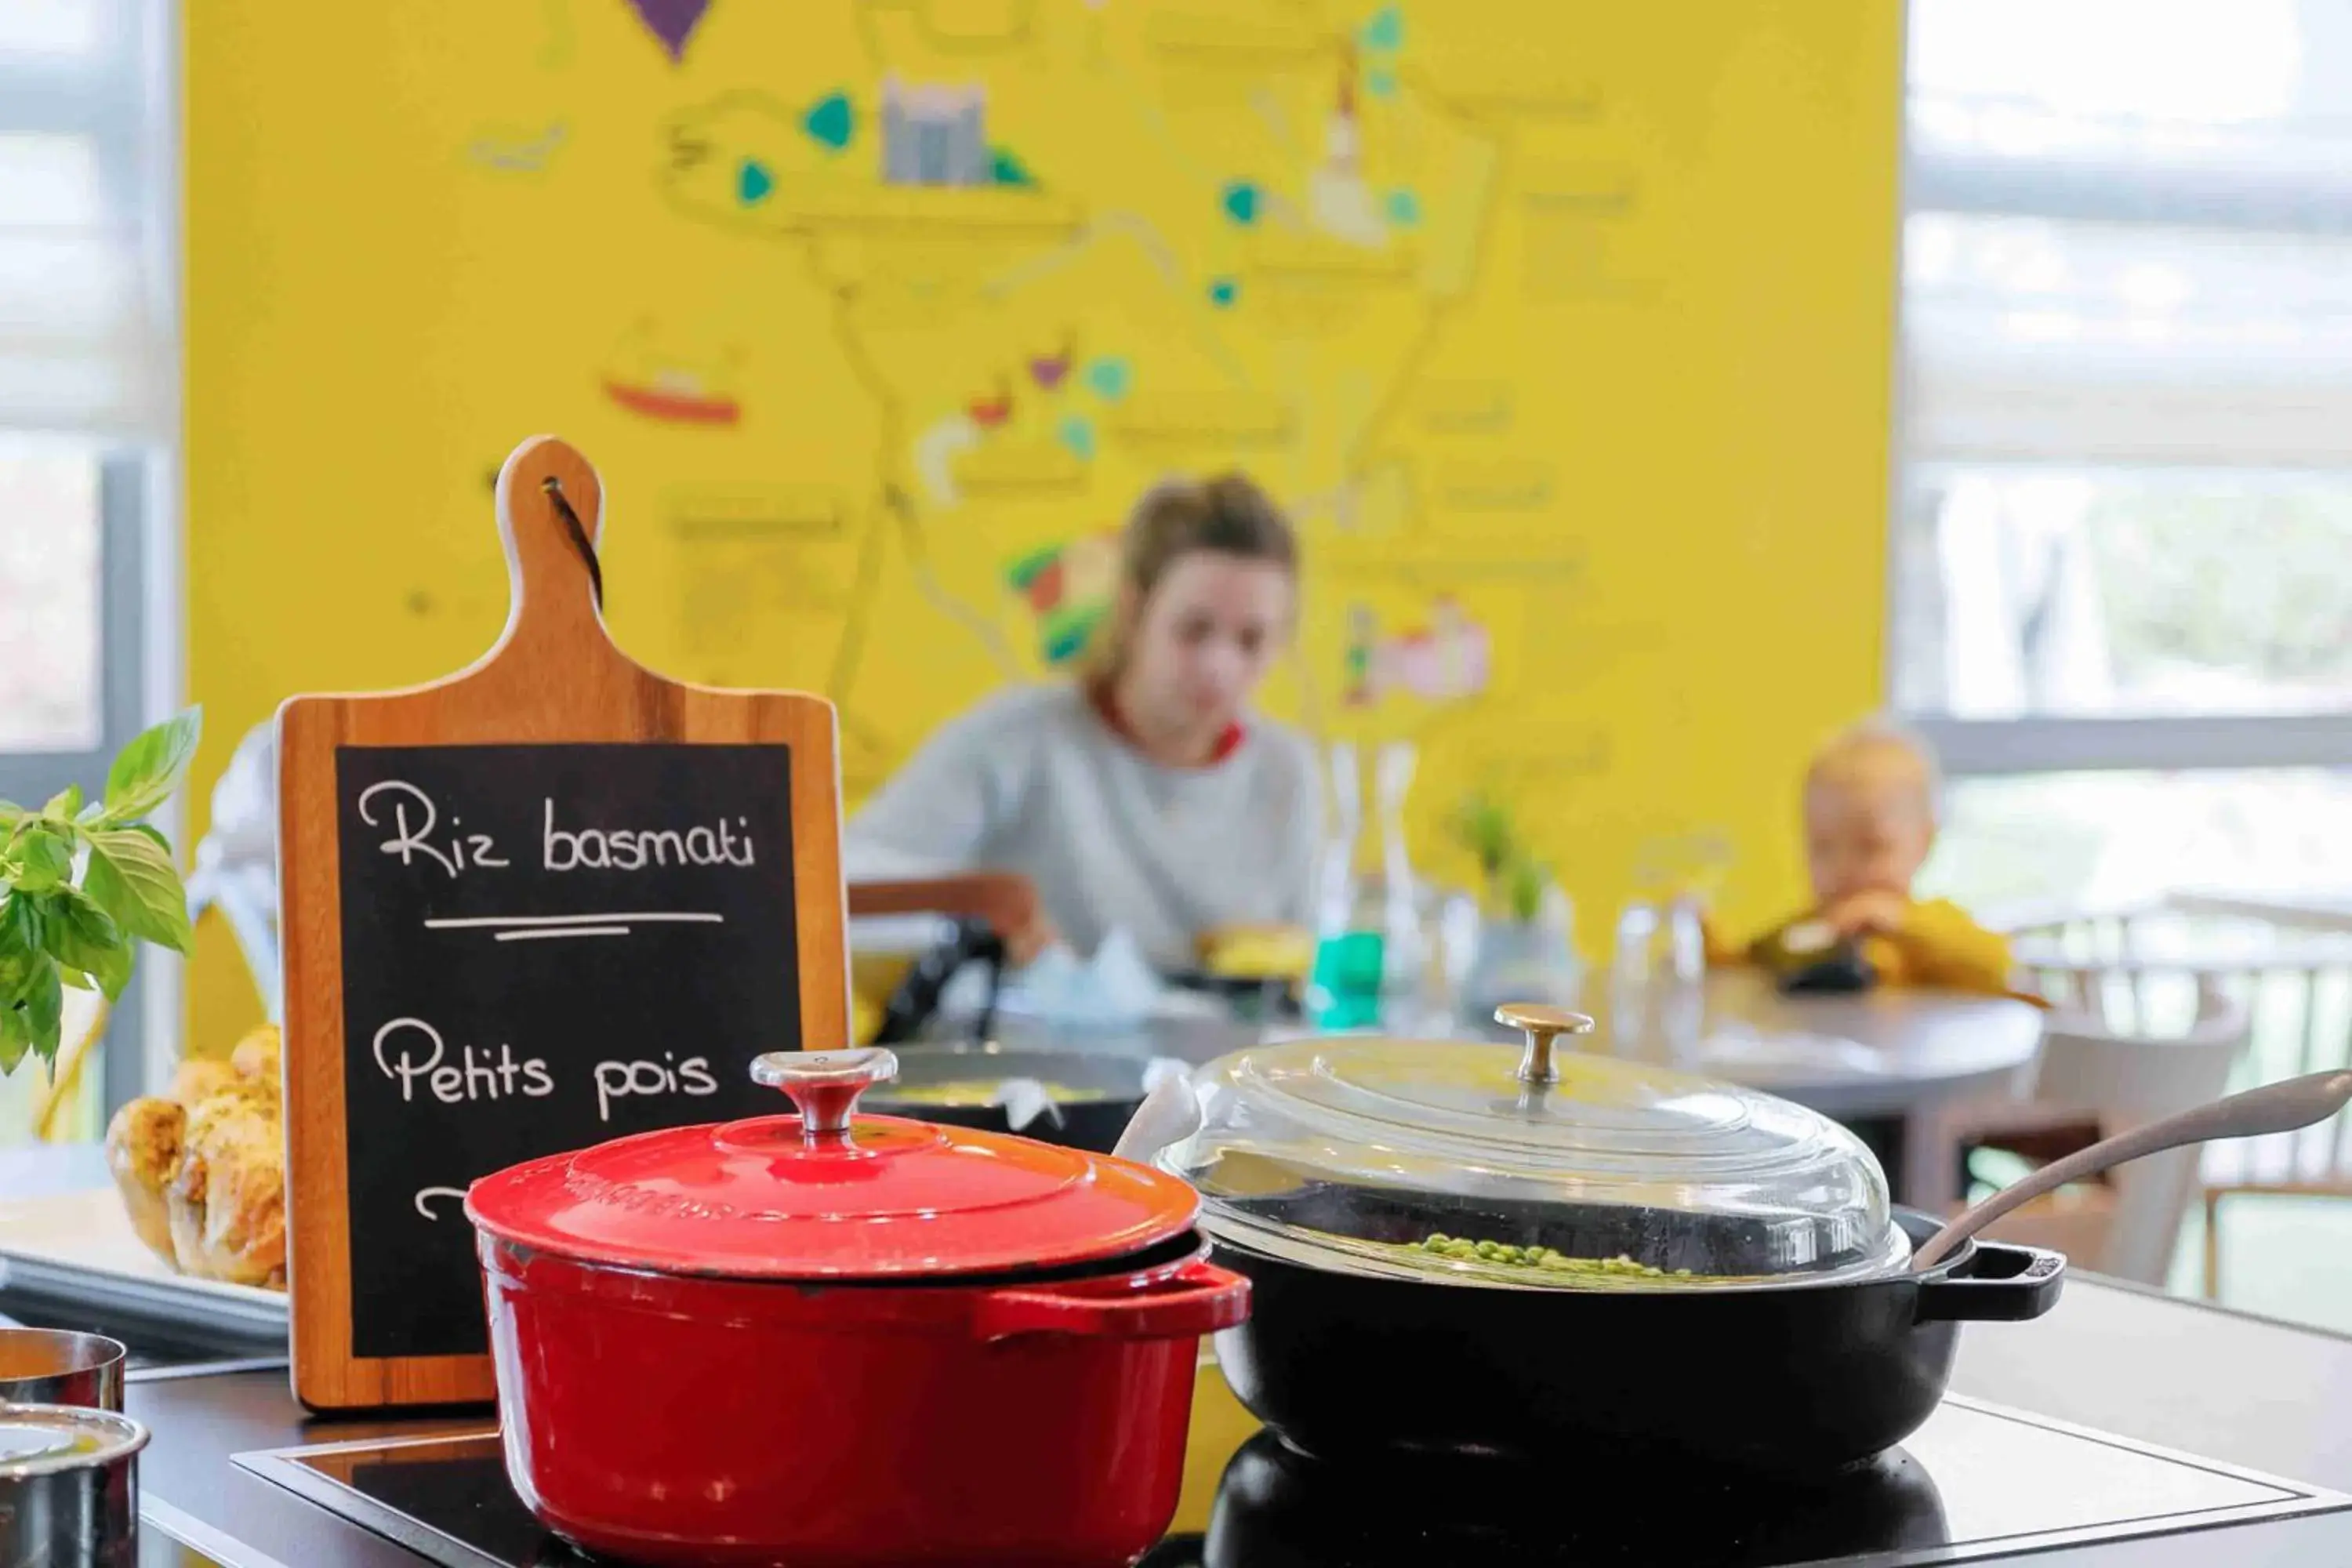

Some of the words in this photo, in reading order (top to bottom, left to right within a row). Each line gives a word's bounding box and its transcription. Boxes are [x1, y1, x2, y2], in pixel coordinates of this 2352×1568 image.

[358, 780, 510, 879] Riz
[543, 797, 754, 871] basmati
[372, 1017, 555, 1104] Petits
[593, 1051, 720, 1122] pois
